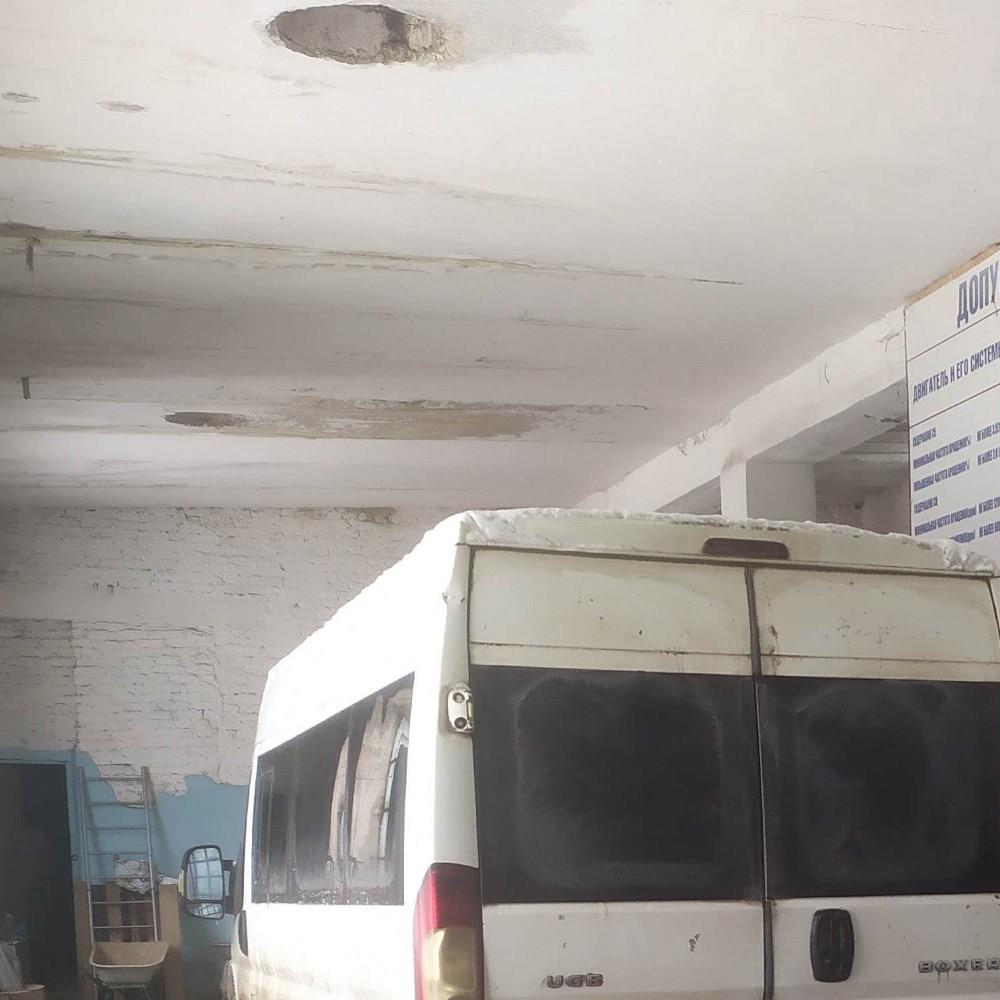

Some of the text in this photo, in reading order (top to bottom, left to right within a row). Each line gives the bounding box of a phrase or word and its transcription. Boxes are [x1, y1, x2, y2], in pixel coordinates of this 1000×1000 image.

[913, 369, 949, 404] ДВИГАТЕЛЬ
[950, 365, 955, 384] И
[956, 358, 969, 380] ЕГО
[918, 957, 1000, 973] BOXER
